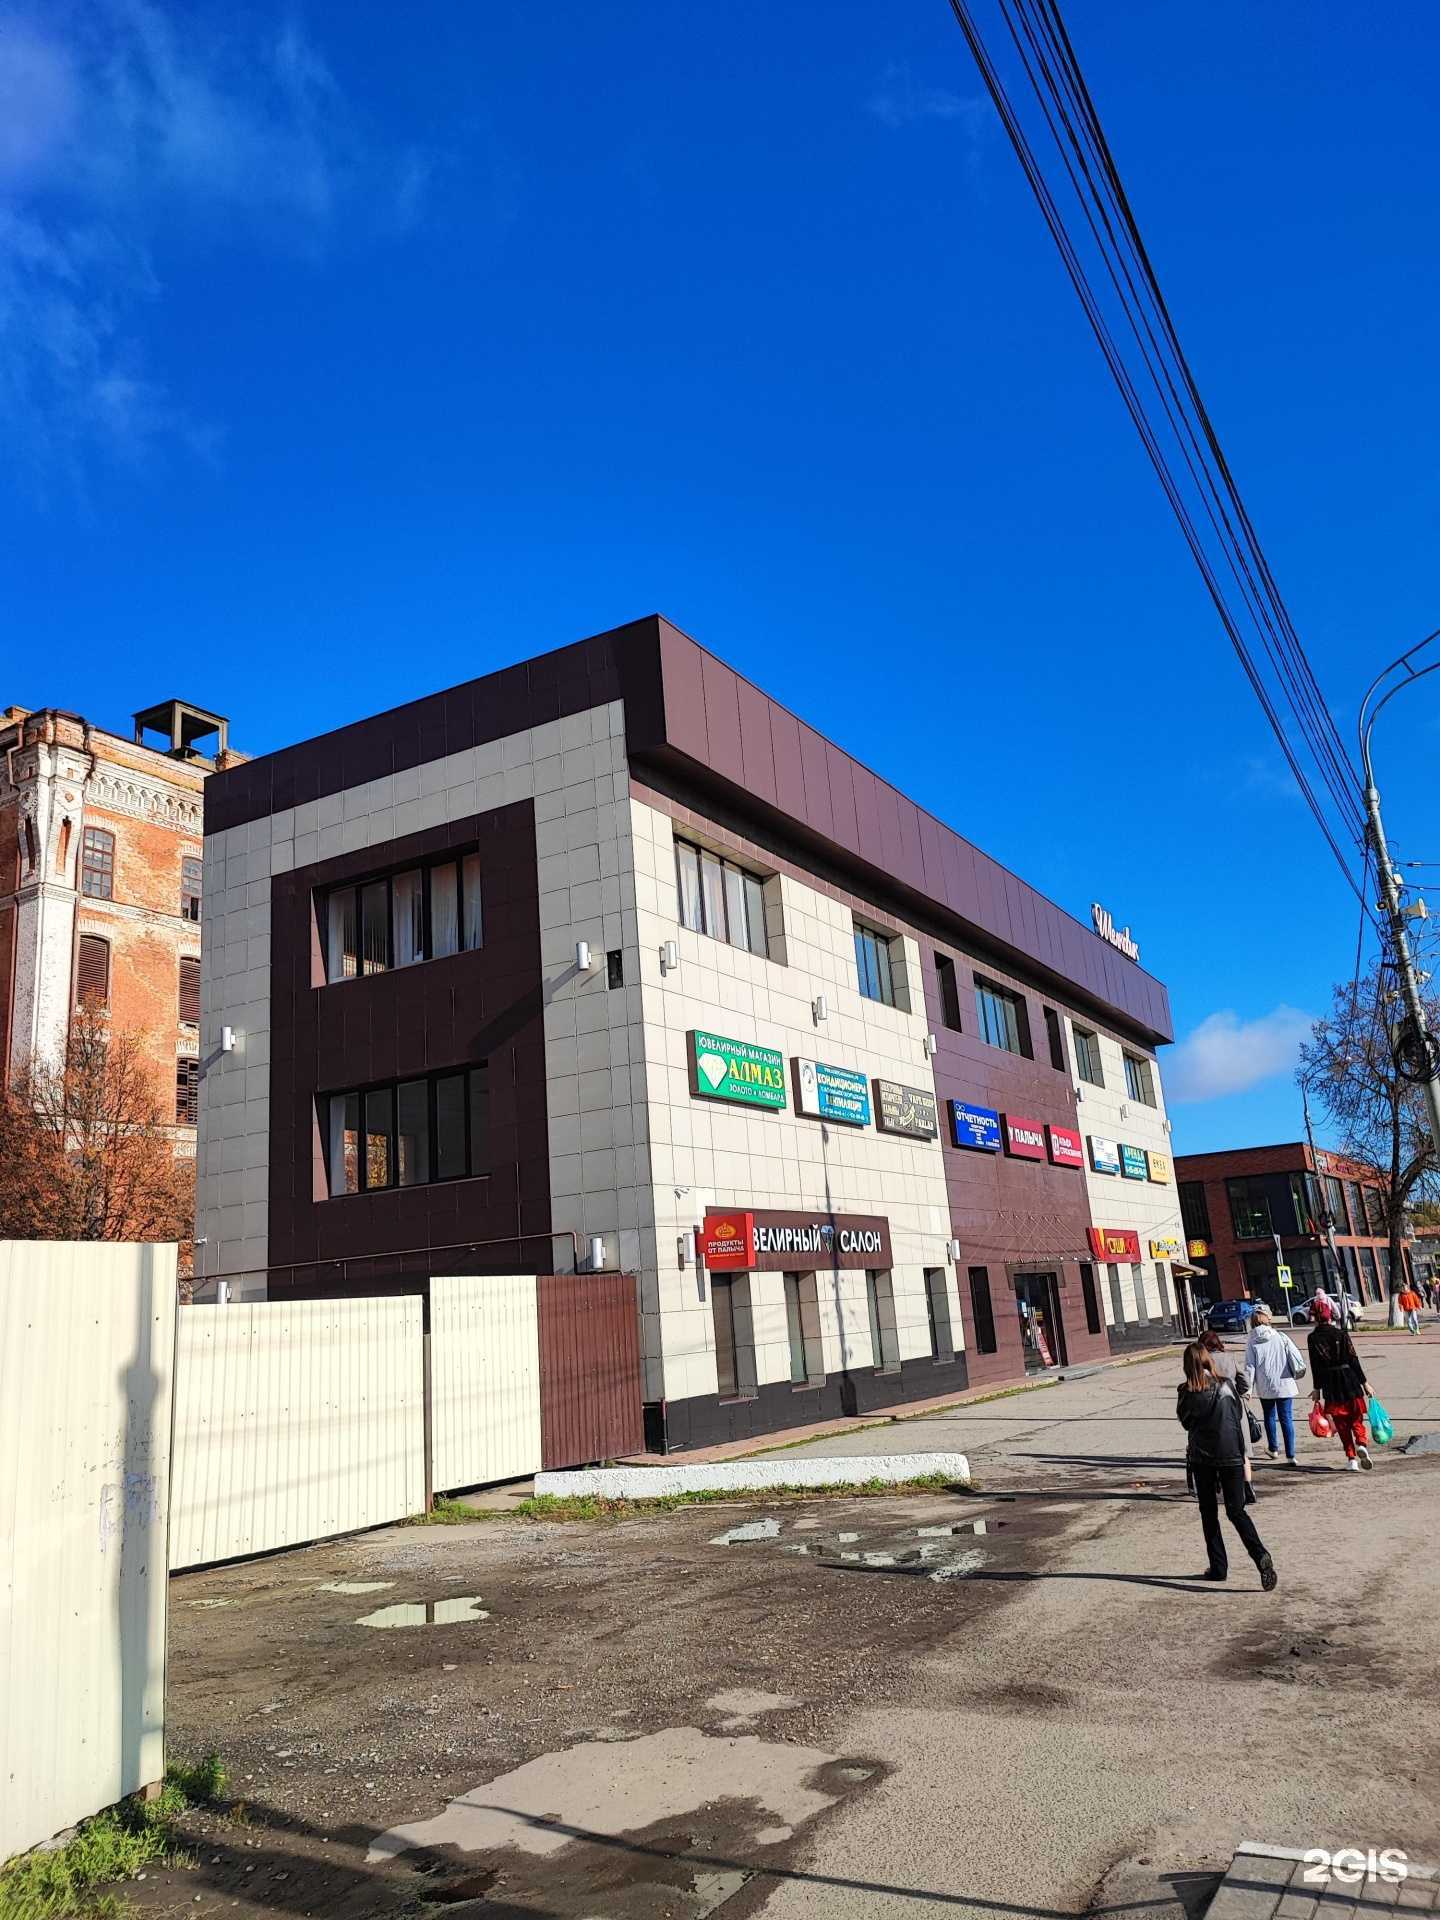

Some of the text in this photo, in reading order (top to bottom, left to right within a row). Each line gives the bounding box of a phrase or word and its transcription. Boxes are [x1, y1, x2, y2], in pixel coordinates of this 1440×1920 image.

[698, 1036, 781, 1066] ЮВЕЛИРНЫЙ МАГАЗИН
[728, 1058, 783, 1089] АЛМАЗ
[817, 1073, 866, 1094] КОНДИЦИОНЕРЫ
[729, 1083, 753, 1096] ЗОЛОТО
[956, 1111, 998, 1128] ОТЧЕТНОСТЬ
[1008, 1126, 1014, 1141] У
[1015, 1128, 1044, 1148] ПАЛЫЧА
[708, 1240, 744, 1248] ПРОДУКТЫ
[753, 1224, 881, 1253] ВЕЛИРНЫЙ САЛОН
